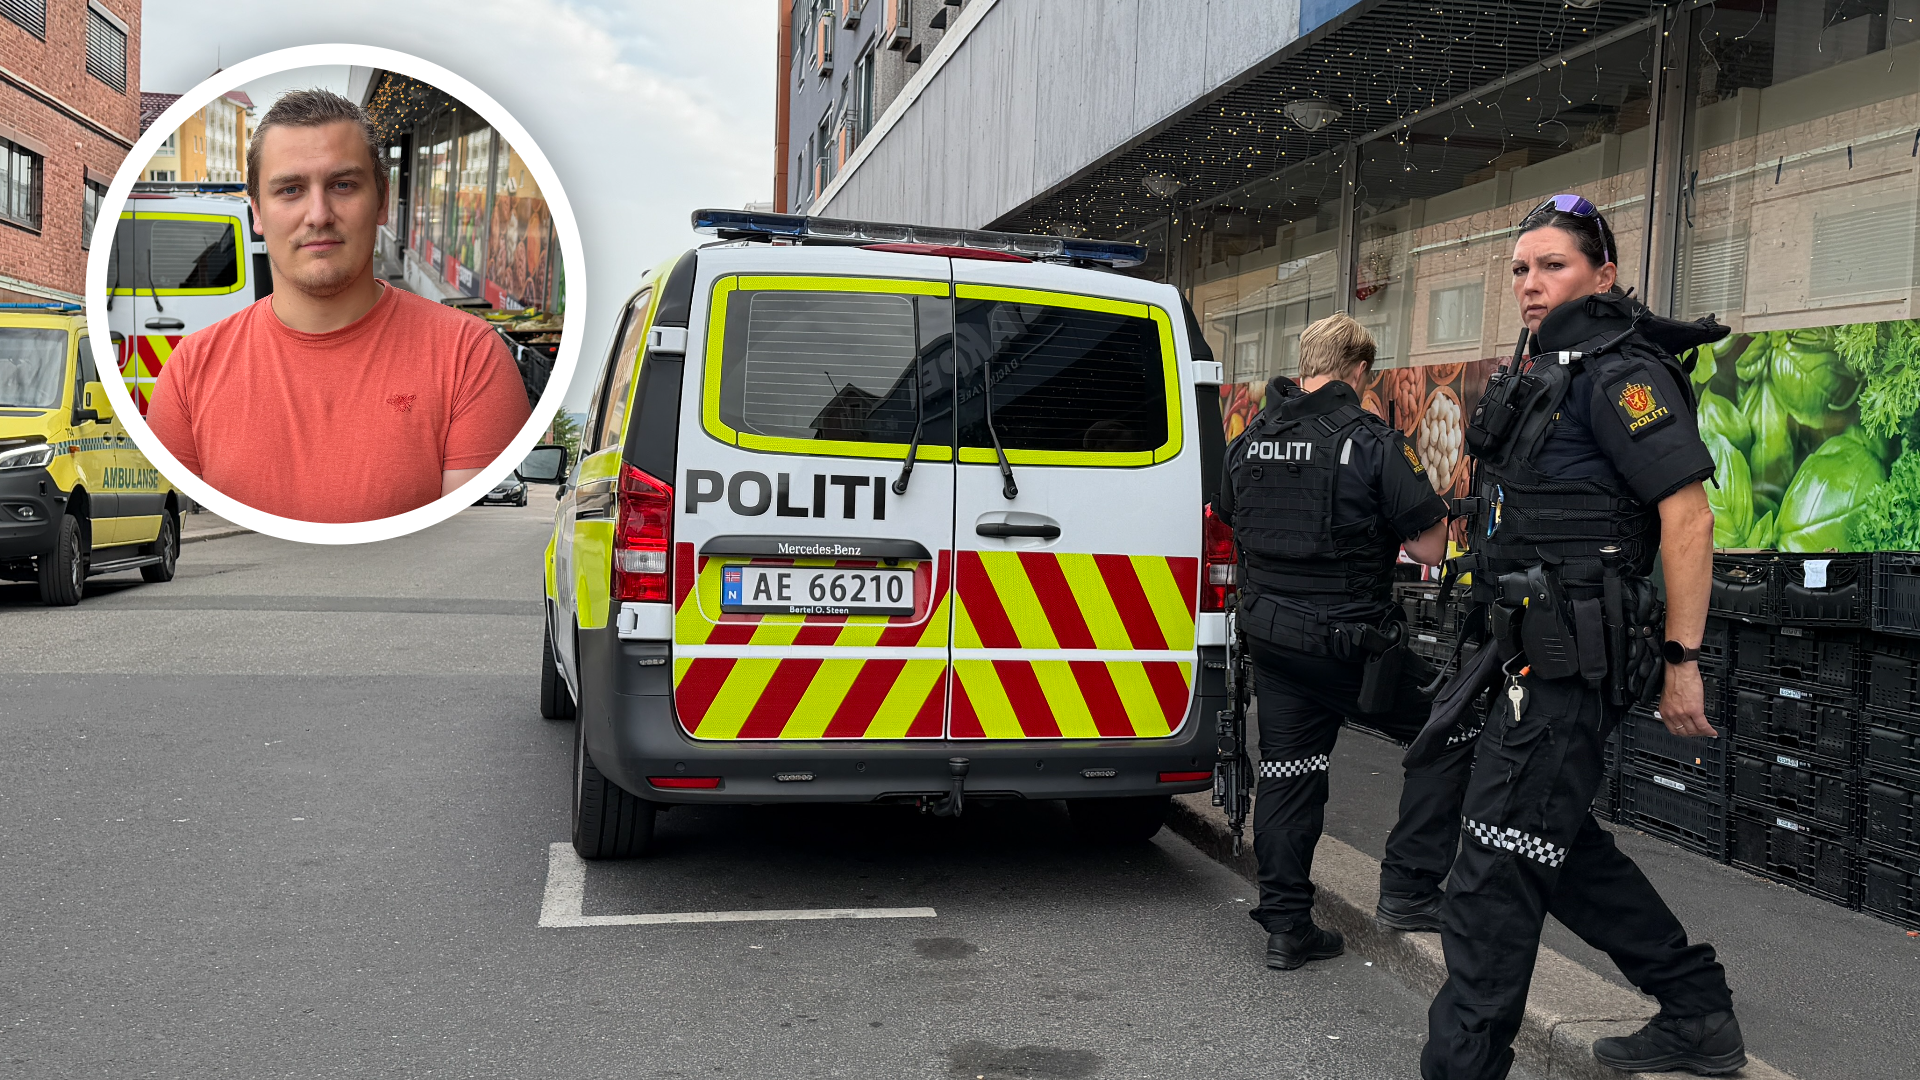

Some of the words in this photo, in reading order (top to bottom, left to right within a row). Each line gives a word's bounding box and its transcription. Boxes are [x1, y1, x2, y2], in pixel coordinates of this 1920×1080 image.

[1629, 406, 1669, 432] POLITI
[1247, 441, 1312, 461] POLITI
[103, 467, 158, 489] AMBULANSE
[685, 469, 886, 520] POLITI
[777, 542, 861, 556] Mercedes-Benz
[728, 591, 737, 600] N
[752, 572, 792, 601] AE
[808, 573, 904, 603] 66210
[789, 605, 814, 614] Bertel
[816, 605, 825, 614] O.
[826, 606, 849, 614] Steen
